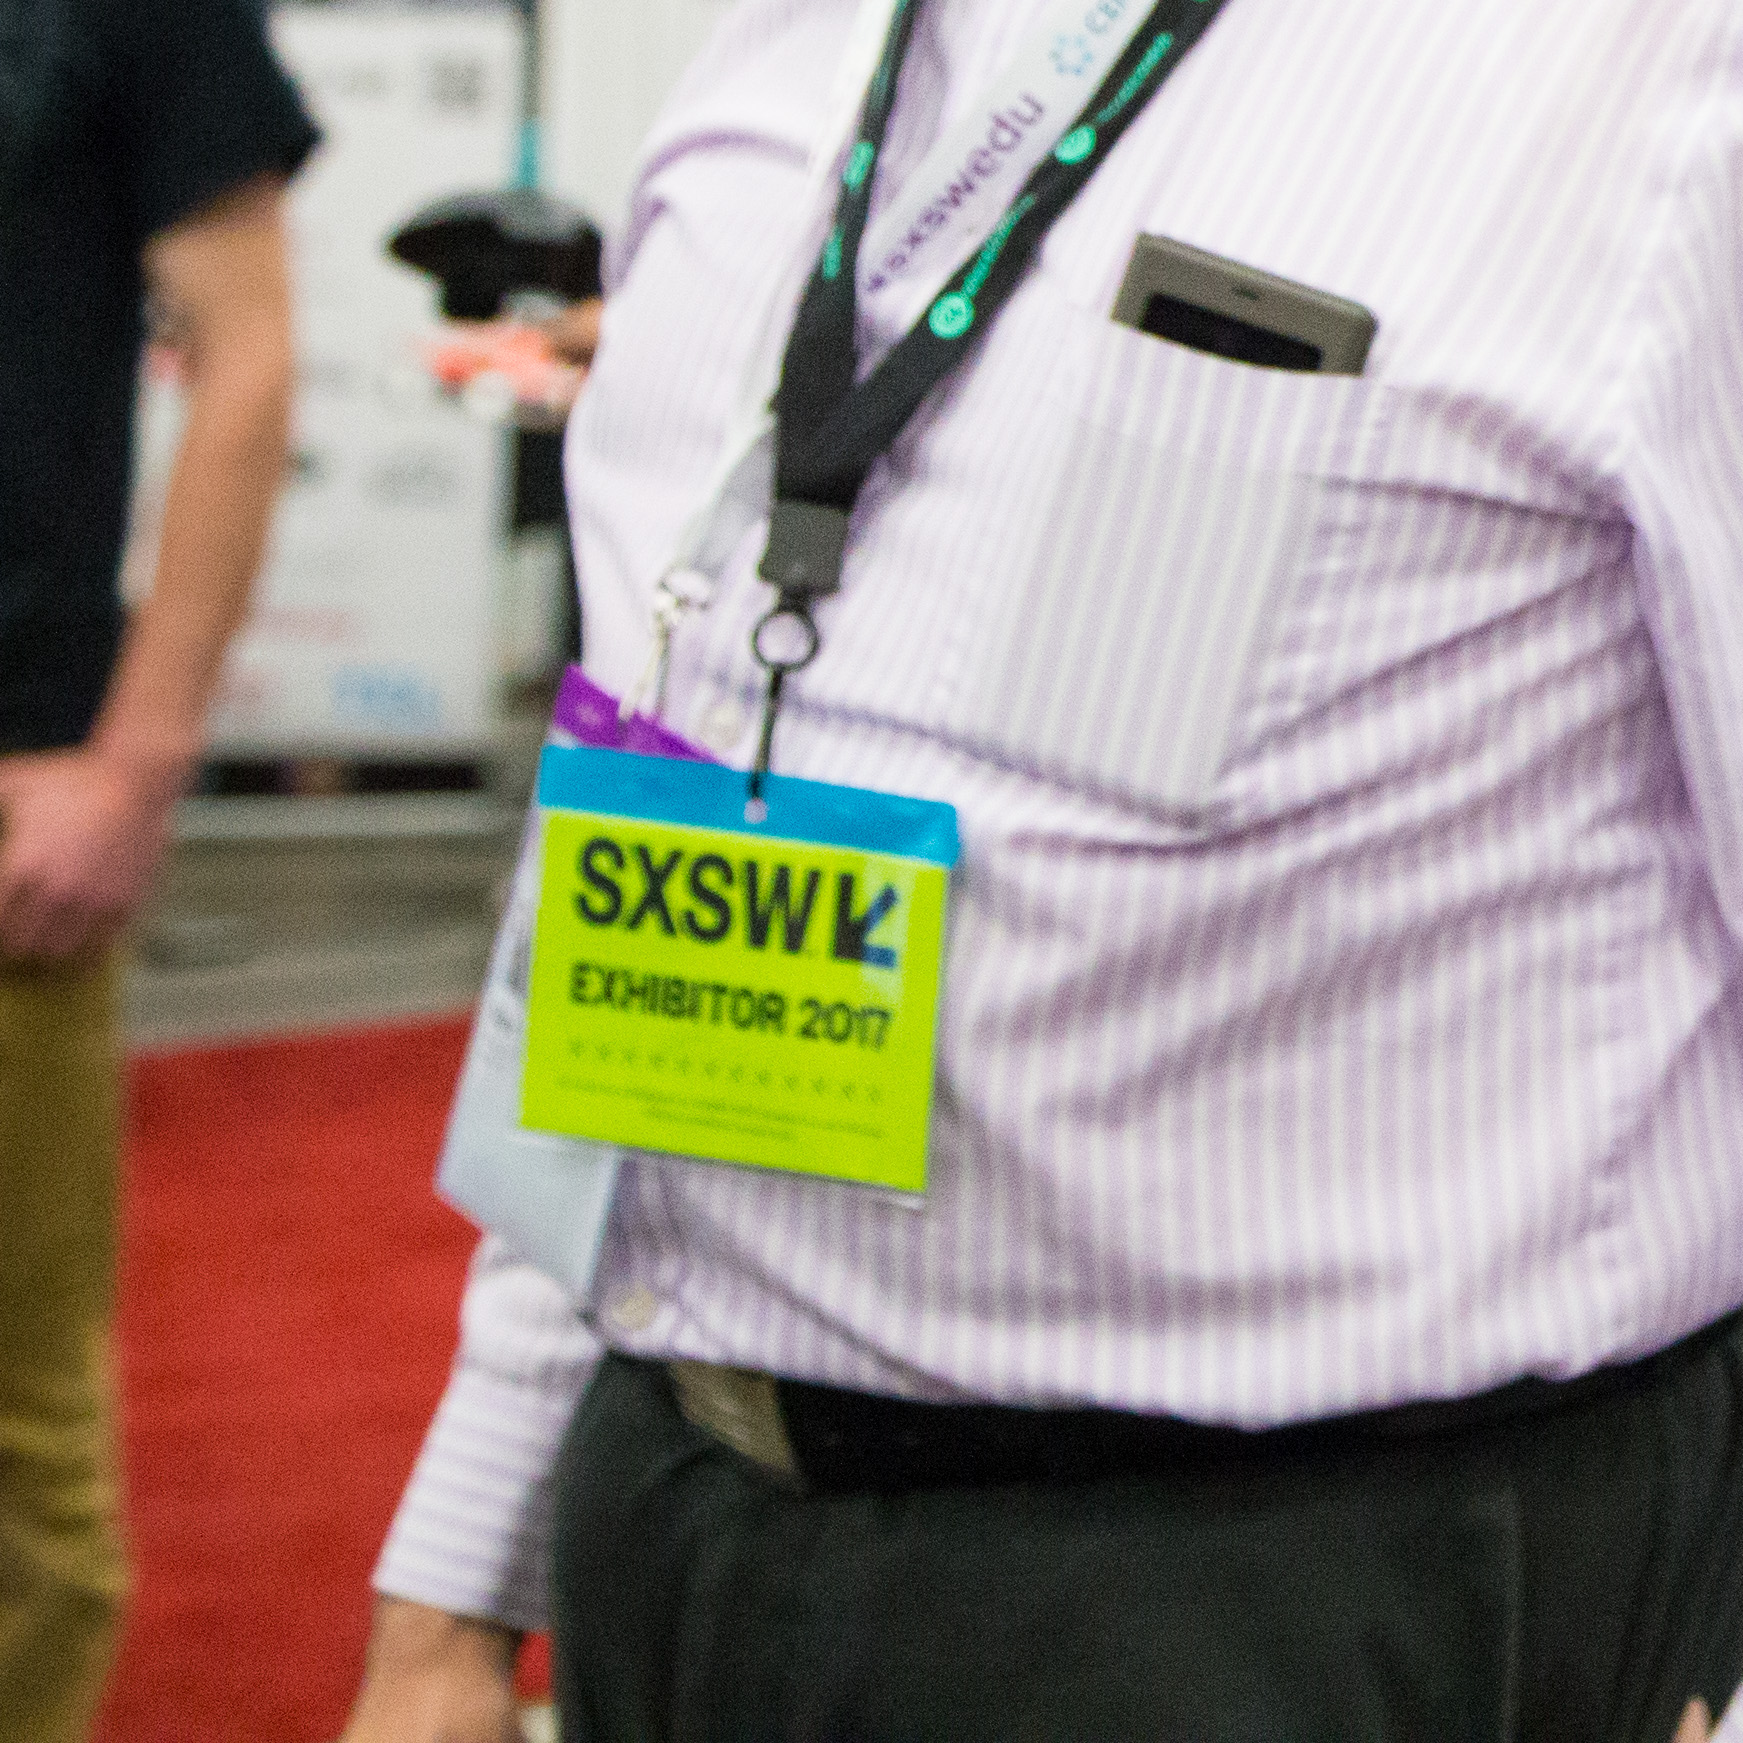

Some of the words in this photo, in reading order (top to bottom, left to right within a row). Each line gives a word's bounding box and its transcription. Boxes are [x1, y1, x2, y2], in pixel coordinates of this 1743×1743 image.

[572, 835, 821, 955] SXSW
[569, 960, 789, 1037] EXHIBITOR
[797, 997, 893, 1051] 2017
